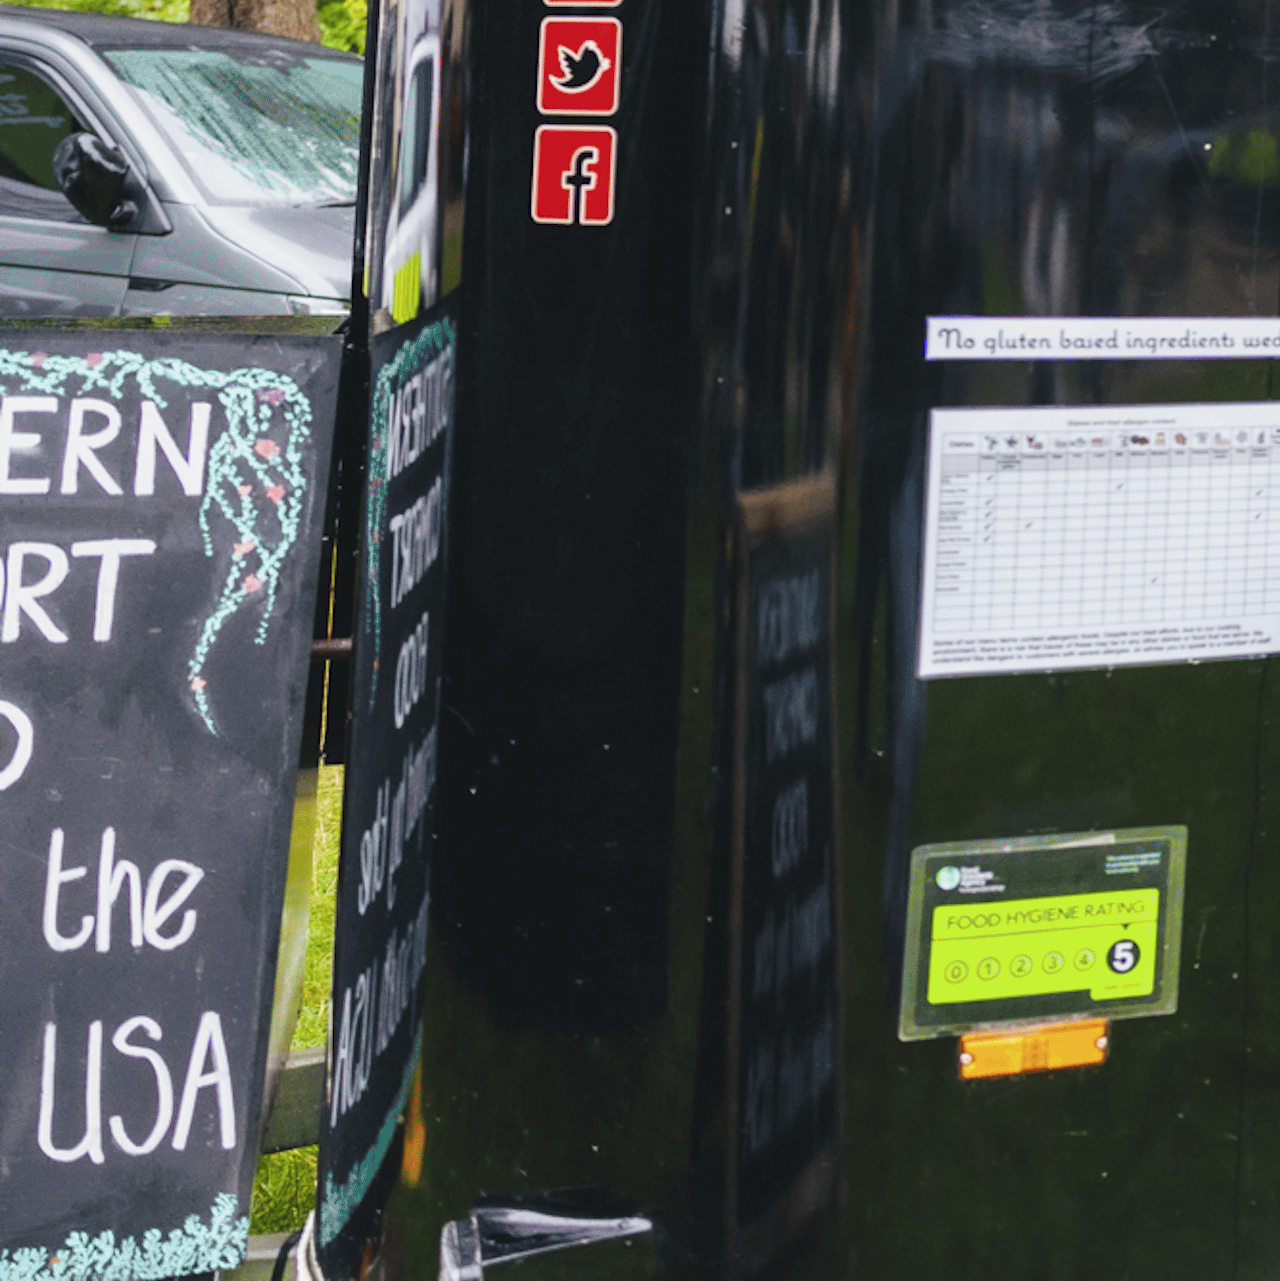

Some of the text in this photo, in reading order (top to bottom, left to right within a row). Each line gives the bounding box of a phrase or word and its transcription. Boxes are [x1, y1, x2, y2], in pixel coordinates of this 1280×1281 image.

[939, 328, 975, 350] No
[984, 330, 1052, 353] gluten
[1060, 330, 1119, 349] based
[1126, 330, 1235, 352] ingredients
[0, 396, 211, 496] ERN
[0, 539, 156, 643] RT
[43, 827, 204, 952] the
[947, 900, 1146, 930] FOOD HYGIENE RATING
[1112, 942, 1134, 972] 5
[38, 1011, 236, 1164] USA
